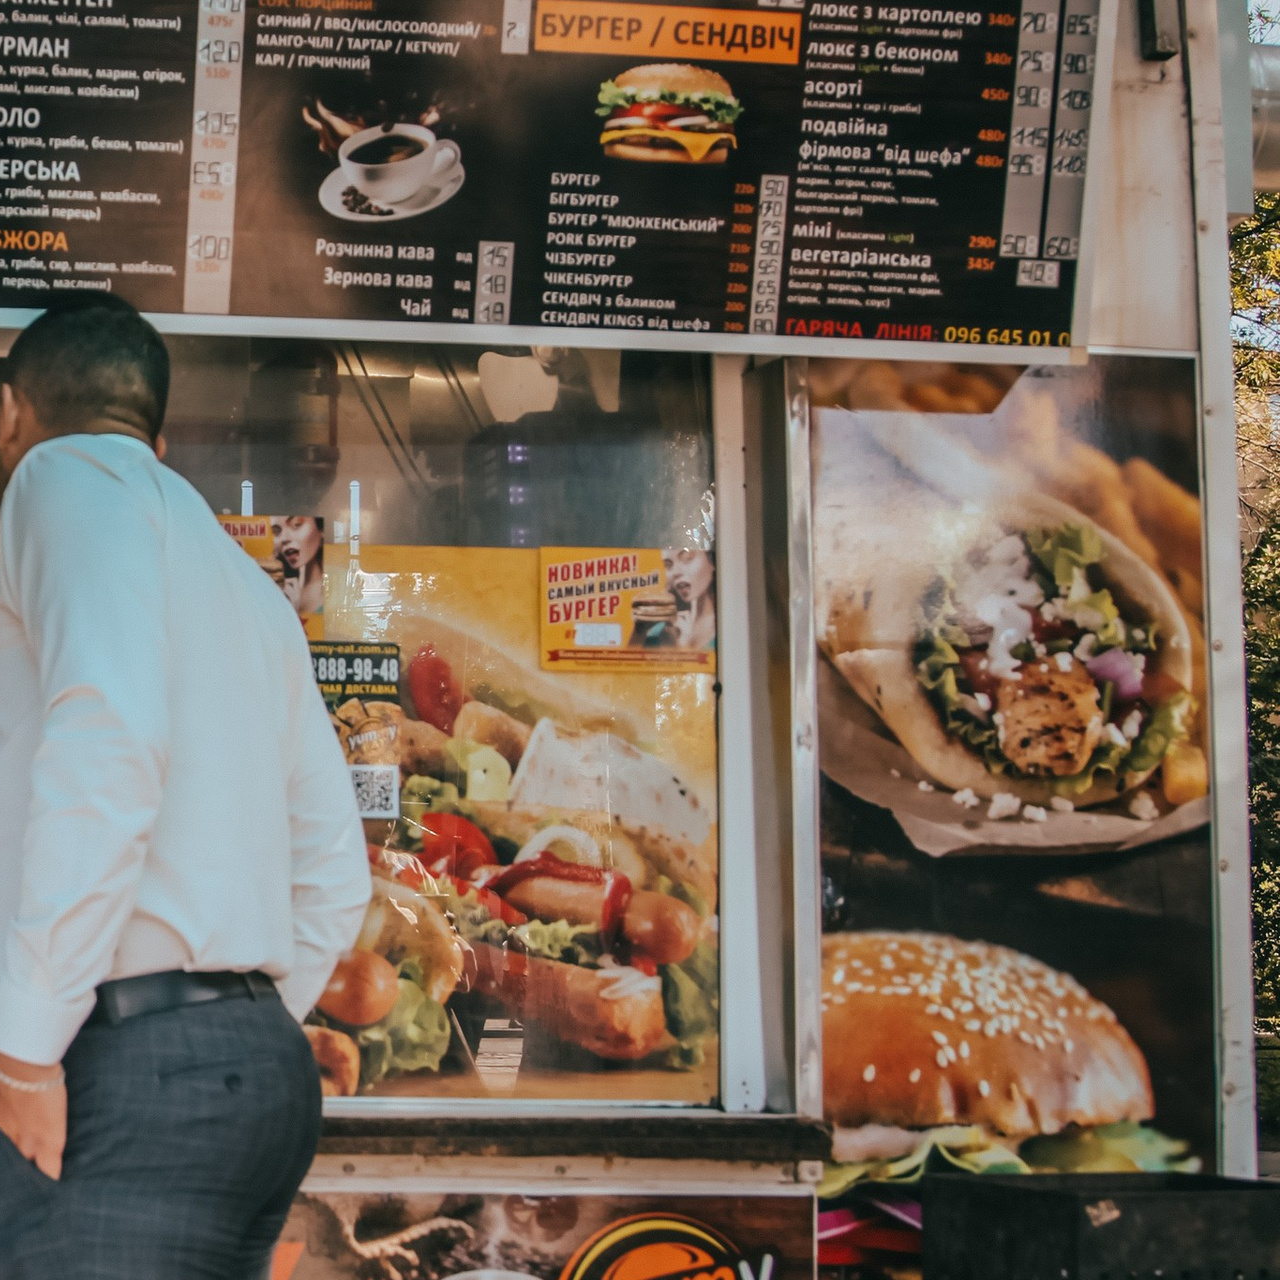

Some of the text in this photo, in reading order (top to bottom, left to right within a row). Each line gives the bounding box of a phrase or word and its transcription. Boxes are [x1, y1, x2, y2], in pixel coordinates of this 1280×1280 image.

[257, 13, 311, 29] СИРНИЙ
[810, 3, 981, 26] люкс картоплею
[257, 33, 333, 50] МАНГО-ЧІЛІ
[347, 38, 392, 52] ТАРТАР
[541, 14, 794, 54] БУРГЕР СЕНДВІЧ
[255, 53, 370, 70] КАРІ ГІРЧИЧНИЙ
[807, 42, 959, 63] люкс беконом
[804, 79, 862, 98] асорті
[981, 89, 1010, 101] 450г
[801, 118, 888, 136] подвійна
[799, 140, 870, 160] фірмова
[551, 172, 600, 187] БУРГЕР
[550, 192, 619, 208] БІГБУРГЕР
[548, 212, 597, 226] БУРГЕР
[792, 221, 831, 239] міні
[547, 232, 636, 249] PORK БУРГЕР
[969, 235, 997, 248] 290г
[316, 239, 472, 263] Розчинна кава від
[545, 252, 615, 267] ЧІЗБУРГЕР
[790, 246, 931, 268] вегетаріанська
[324, 267, 470, 291] Зернова кава від
[544, 272, 633, 288] ЧІКЕНБУРГЕР
[401, 299, 468, 319] Чай від
[542, 291, 675, 309] СЕНДВІЧ баликом
[541, 311, 710, 332] СЕНДВІЧ KINGS від шефа
[785, 318, 862, 338] ГАРЯЧА
[944, 327, 981, 343] 096
[986, 328, 1022, 345] 645
[1028, 330, 1050, 346] 01
[548, 554, 637, 583] НОВИНКА!
[548, 571, 659, 600] САМЫЙ ВКУСНЫЙ
[549, 595, 620, 624] БУРГЕР
[345, 684, 397, 695] ДОСТАВКА
